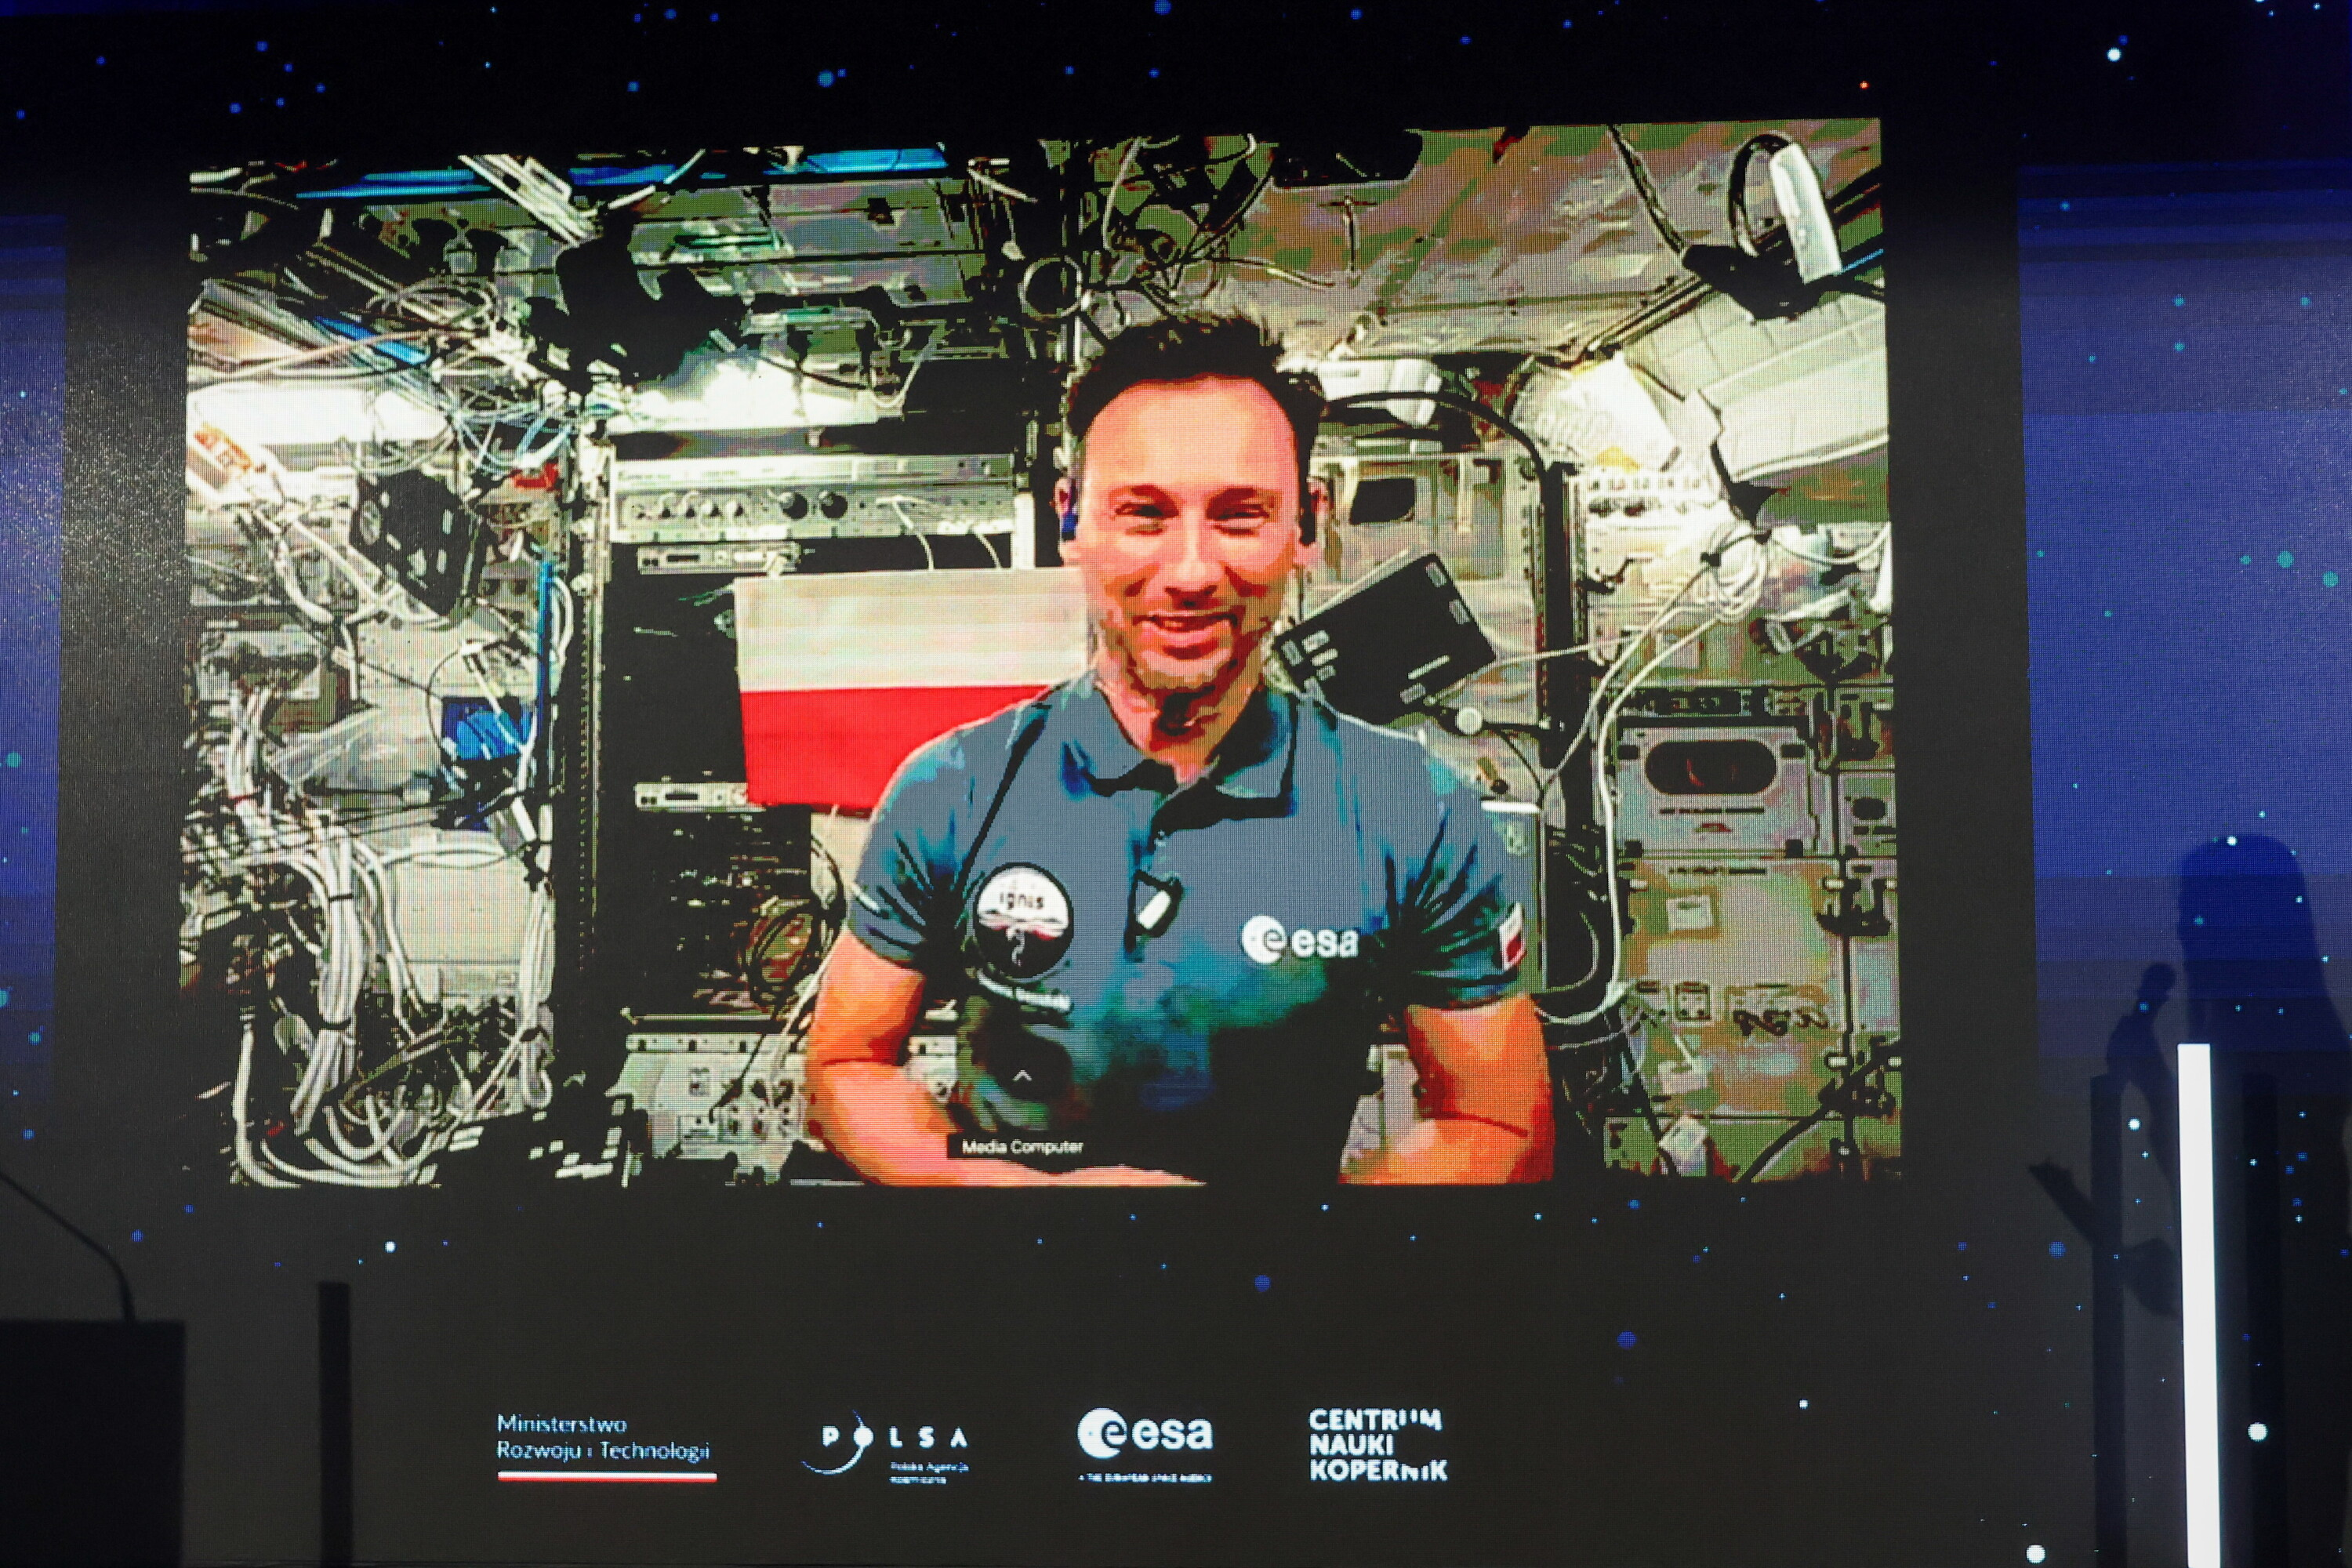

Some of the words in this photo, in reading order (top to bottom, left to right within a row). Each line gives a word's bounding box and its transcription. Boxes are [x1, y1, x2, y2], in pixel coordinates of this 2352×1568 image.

[1292, 929, 1359, 958] esa
[963, 1139, 1007, 1154] Media
[1011, 1139, 1084, 1156] Computer
[497, 1414, 628, 1433] Ministerstwo
[1308, 1407, 1443, 1432] CENTRUM
[822, 1425, 969, 1449] POLSA
[1131, 1417, 1215, 1451] esa
[1309, 1433, 1395, 1457] NAUKI
[497, 1440, 582, 1463] Rozwoju
[586, 1443, 593, 1459] i
[1309, 1459, 1449, 1482] KOPERNIK
